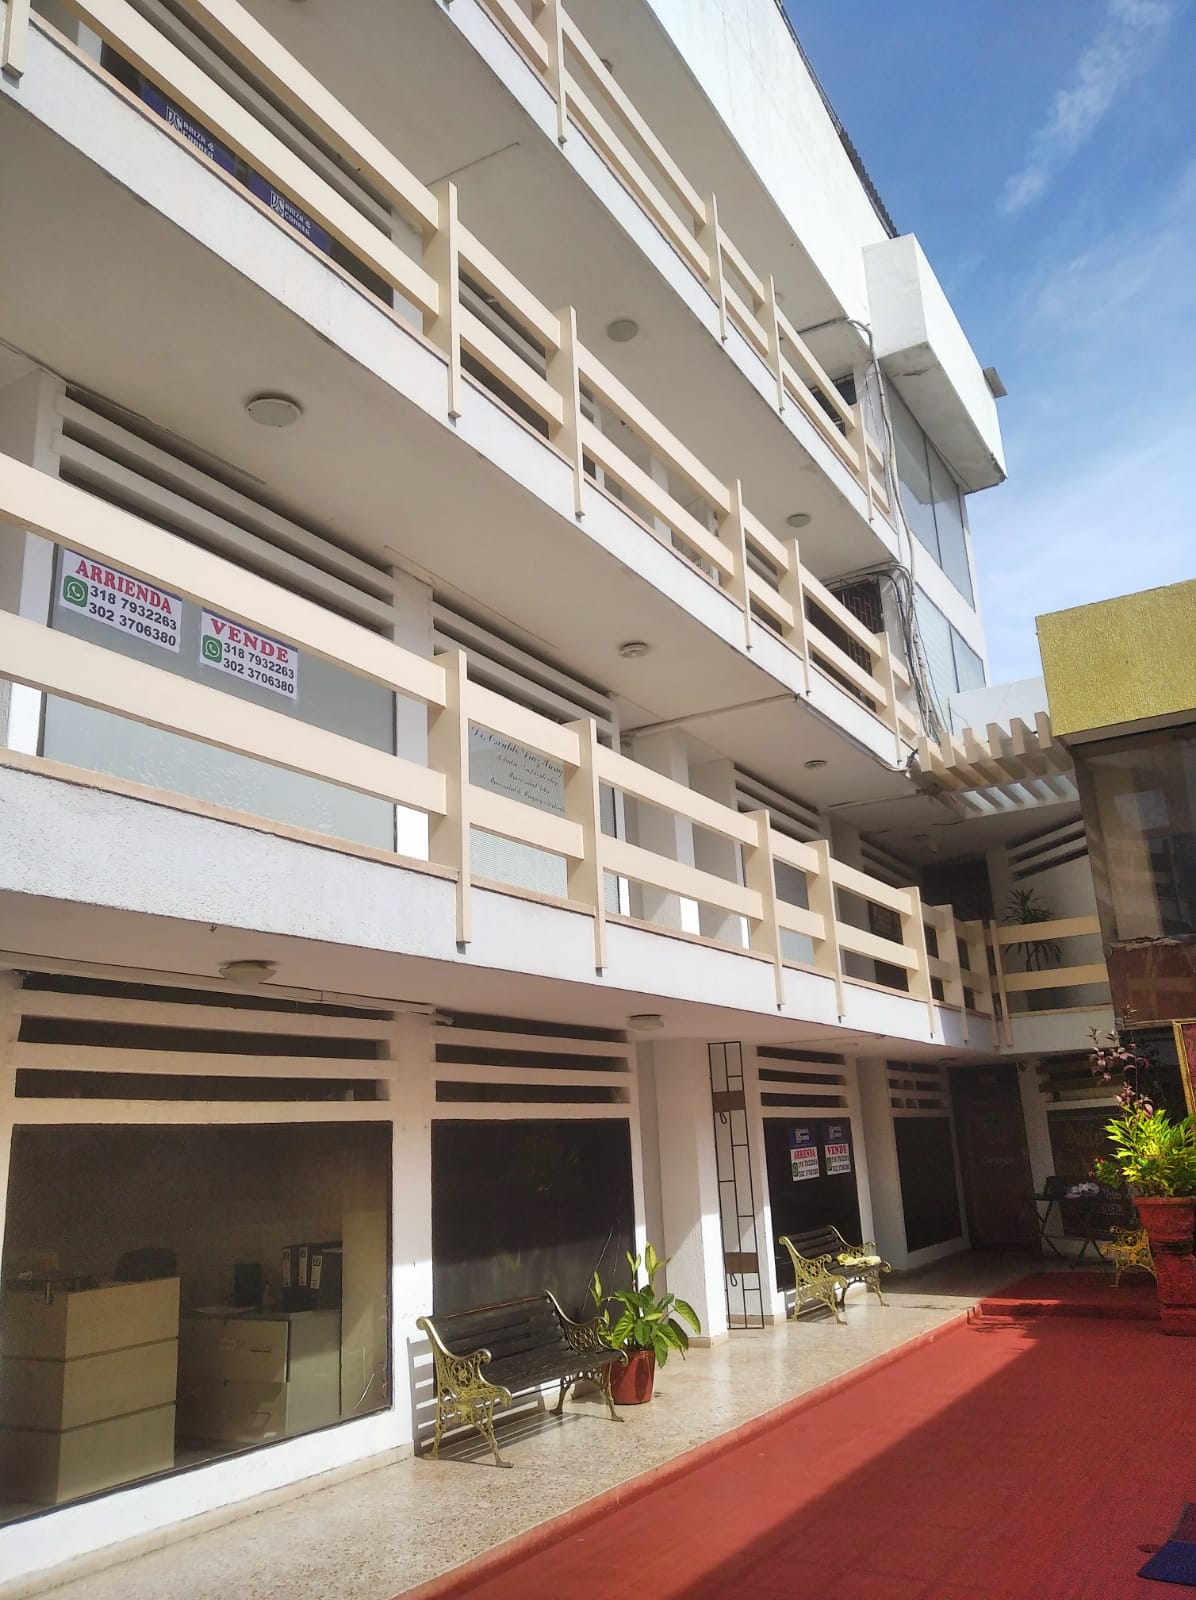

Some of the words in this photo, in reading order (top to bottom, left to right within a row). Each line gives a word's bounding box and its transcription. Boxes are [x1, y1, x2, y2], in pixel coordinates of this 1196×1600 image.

[75, 559, 172, 615] ARRIENDA
[90, 585, 116, 605] 318
[120, 597, 177, 631] 7932263
[89, 602, 115, 622] 302
[119, 614, 176, 646] 3706380
[211, 618, 289, 664] VENDE
[223, 657, 245, 674] 302
[247, 667, 294, 694] 3706380
[224, 642, 245, 659] 318
[248, 652, 295, 679] 7932263
